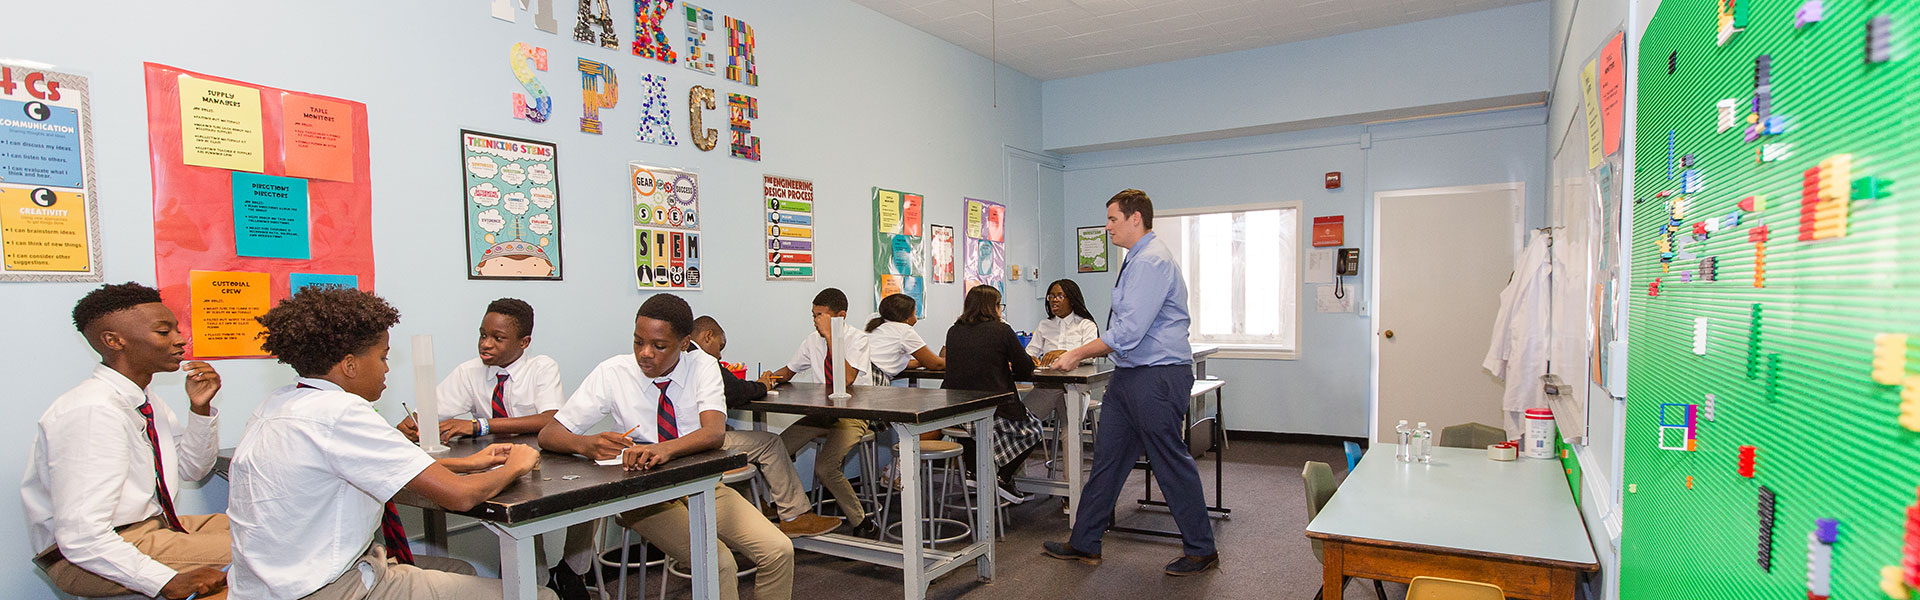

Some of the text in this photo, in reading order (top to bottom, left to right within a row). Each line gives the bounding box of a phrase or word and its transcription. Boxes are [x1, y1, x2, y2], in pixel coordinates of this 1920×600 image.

[24, 72, 61, 101] Cs
[208, 90, 234, 99] SUPPLY
[202, 96, 240, 108] MANAGERS
[510, 42, 761, 161] SPACE
[310, 106, 328, 114] TABLE
[304, 113, 334, 122] MONITORS
[0, 119, 74, 133] COMMUNICATION
[468, 136, 552, 157] THINKING STEMS
[252, 183, 290, 192] DIRECTIONS
[636, 177, 653, 188] GEAR
[764, 176, 813, 192] THE ENGINEERING
[254, 190, 288, 198] DIRECTORS
[676, 186, 692, 194] SUCCESS
[764, 187, 814, 201] DESIGN PROCESS
[20, 208, 68, 216] CREATIVITY
